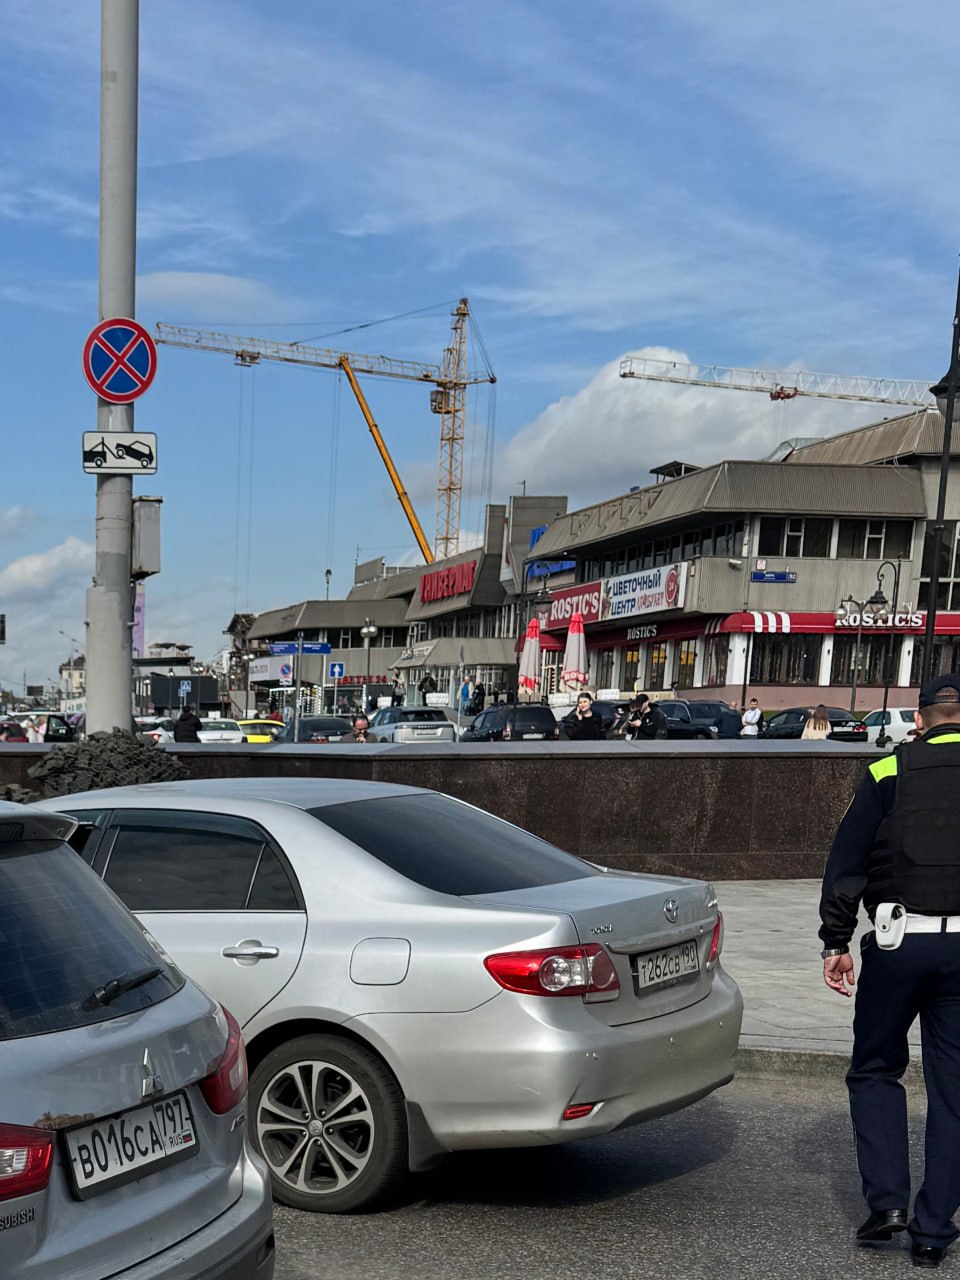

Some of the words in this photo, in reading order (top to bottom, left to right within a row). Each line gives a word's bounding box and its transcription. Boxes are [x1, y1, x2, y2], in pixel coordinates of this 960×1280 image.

[613, 570, 661, 596] ЦВЕТОЧНЫЙ
[550, 591, 599, 621] ROSTIC'S
[611, 598, 636, 616] ЦЕНТР
[627, 624, 657, 640] ROSTIC'S
[642, 953, 681, 985] Т262СВ
[681, 944, 695, 965] 190
[77, 1119, 163, 1180] В016СА
[155, 1099, 185, 1137] 797
[169, 1134, 183, 1147] RUS
